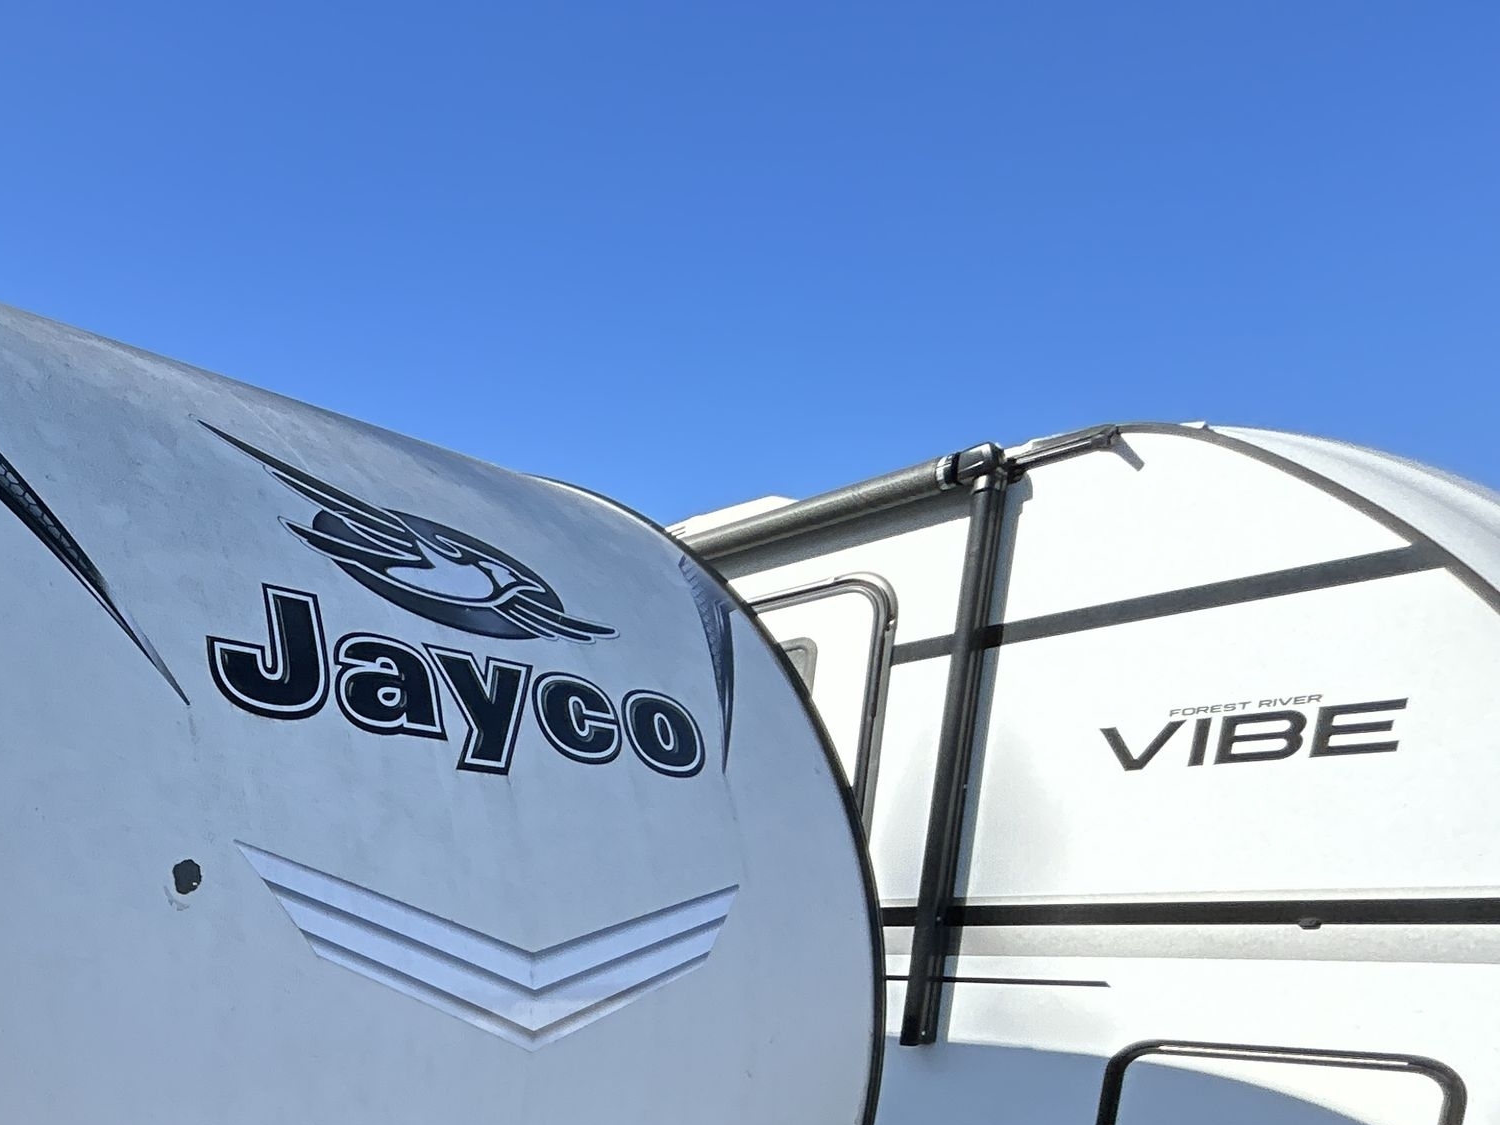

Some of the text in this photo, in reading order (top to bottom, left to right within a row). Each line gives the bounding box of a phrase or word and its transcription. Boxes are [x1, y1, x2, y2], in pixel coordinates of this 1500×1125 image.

[205, 583, 706, 778] Jayco
[1169, 694, 1324, 717] FOREST RIVER
[1099, 697, 1408, 772] VIBE
